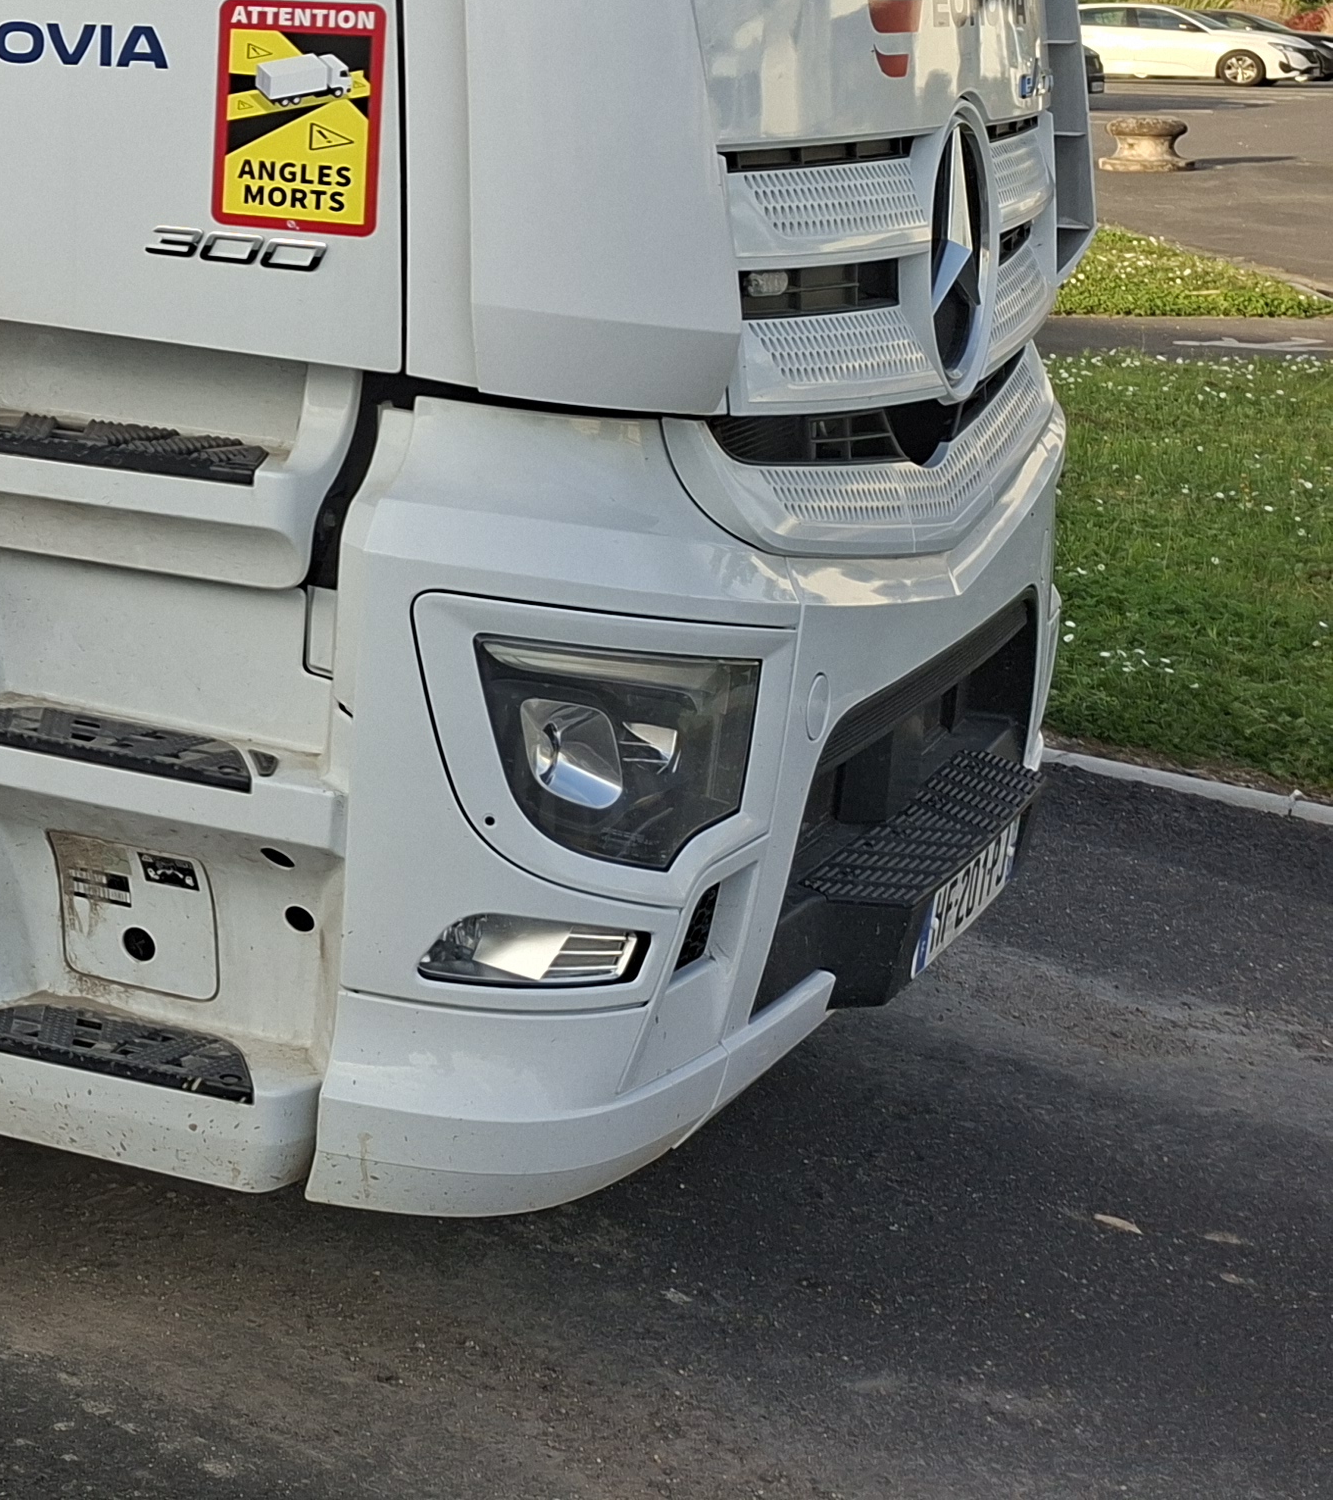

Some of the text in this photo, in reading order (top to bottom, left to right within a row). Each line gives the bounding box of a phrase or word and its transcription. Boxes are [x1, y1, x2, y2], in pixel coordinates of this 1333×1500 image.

[230, 5, 376, 30] ATTENTION
[237, 159, 352, 188] ANGLES
[243, 184, 346, 213] MORTS
[144, 225, 328, 273] 300
